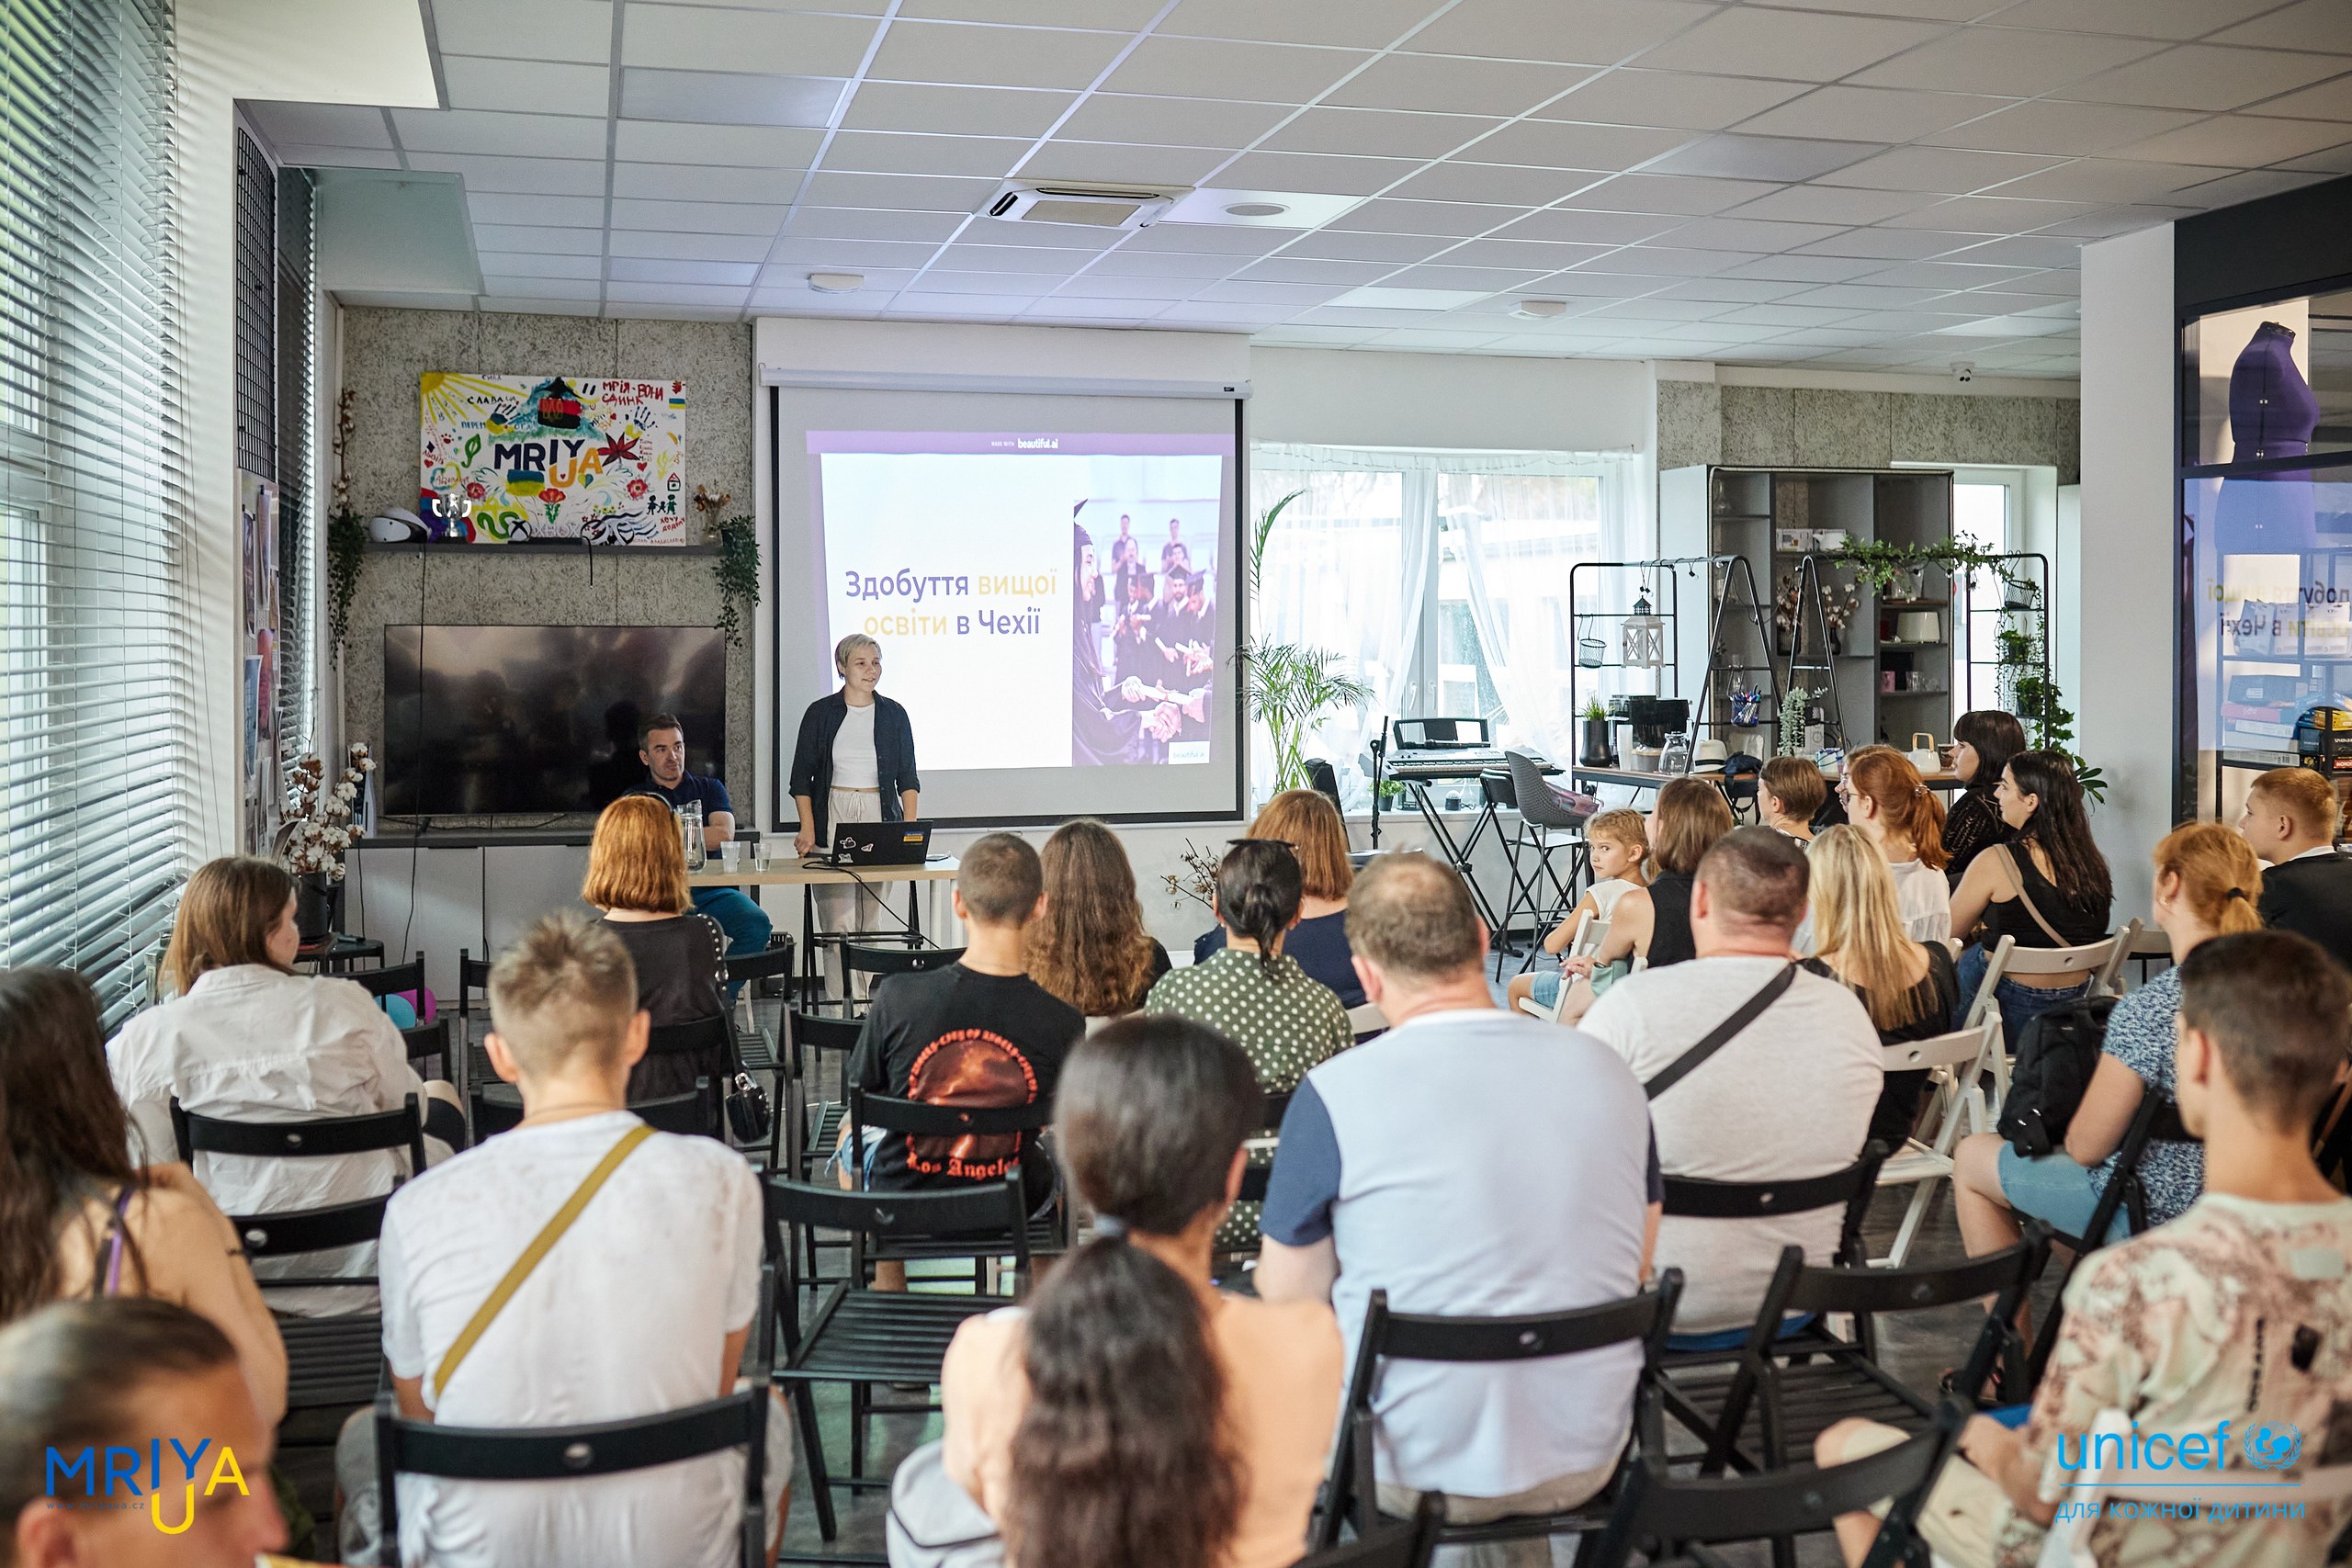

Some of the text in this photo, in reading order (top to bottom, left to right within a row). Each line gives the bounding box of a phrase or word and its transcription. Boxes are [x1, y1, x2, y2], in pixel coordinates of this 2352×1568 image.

[638, 383, 663, 401] ВОНИ
[1017, 437, 1058, 449] beautiful.ai
[660, 515, 679, 525] ХОЧУ
[845, 569, 1057, 603] Здобуття вищої
[864, 606, 1041, 636] освіти в Чехії
[906, 1151, 942, 1174] Los
